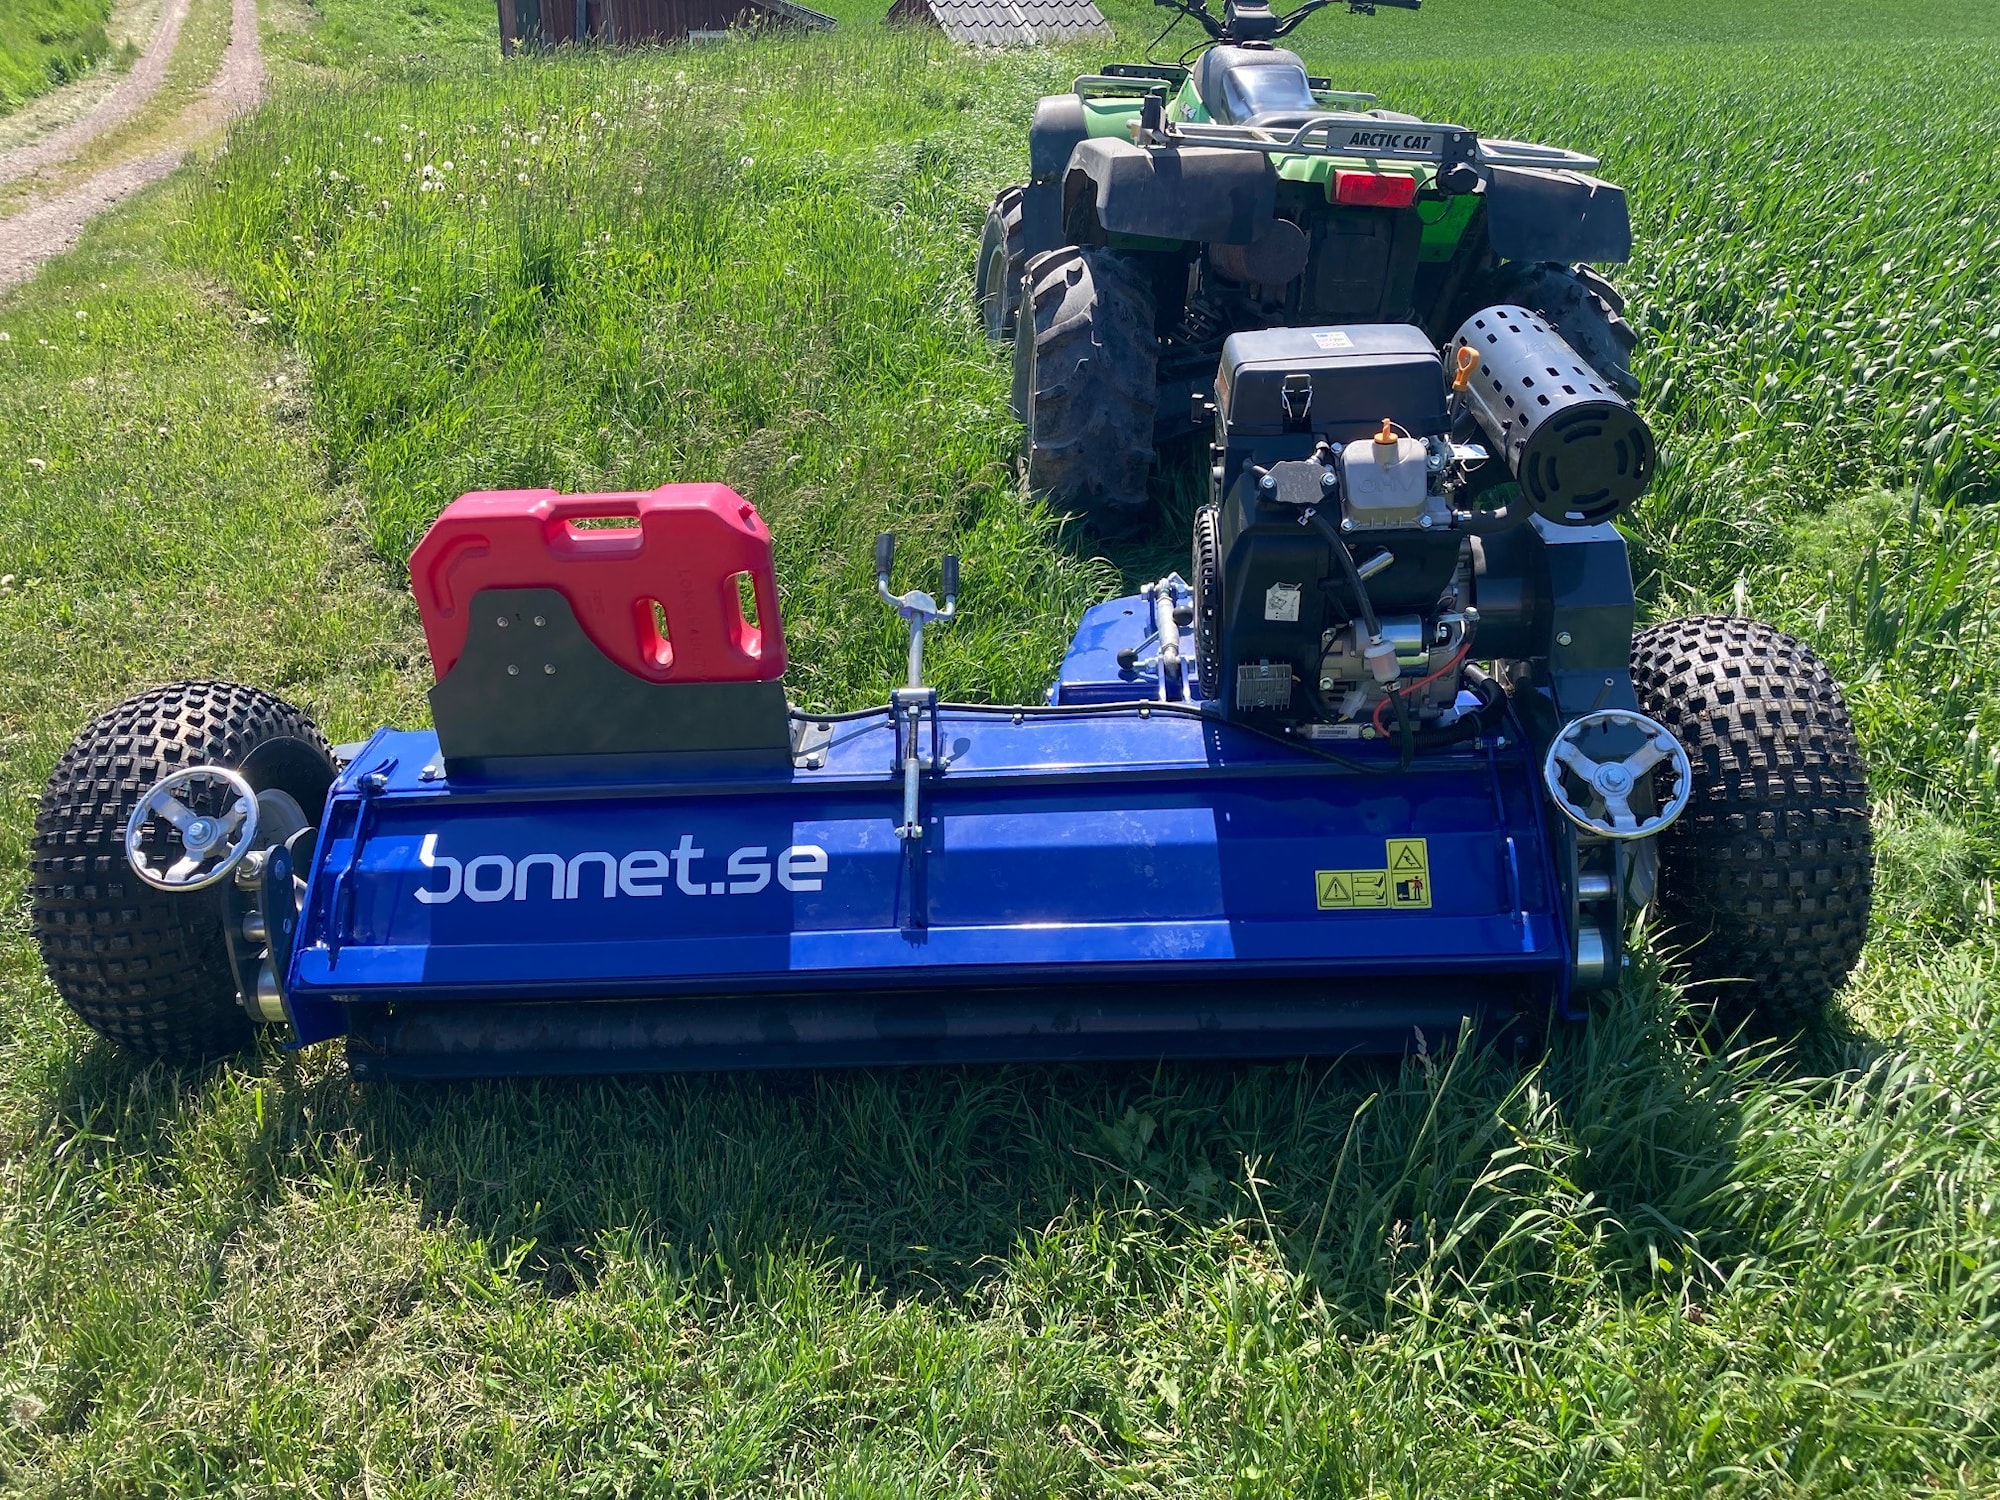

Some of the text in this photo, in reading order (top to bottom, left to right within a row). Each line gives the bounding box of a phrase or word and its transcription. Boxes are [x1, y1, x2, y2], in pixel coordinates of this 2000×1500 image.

[1348, 132, 1431, 149] ARCTIC CAT
[1358, 477, 1416, 493] OHV
[413, 834, 828, 904] bonnet.se
